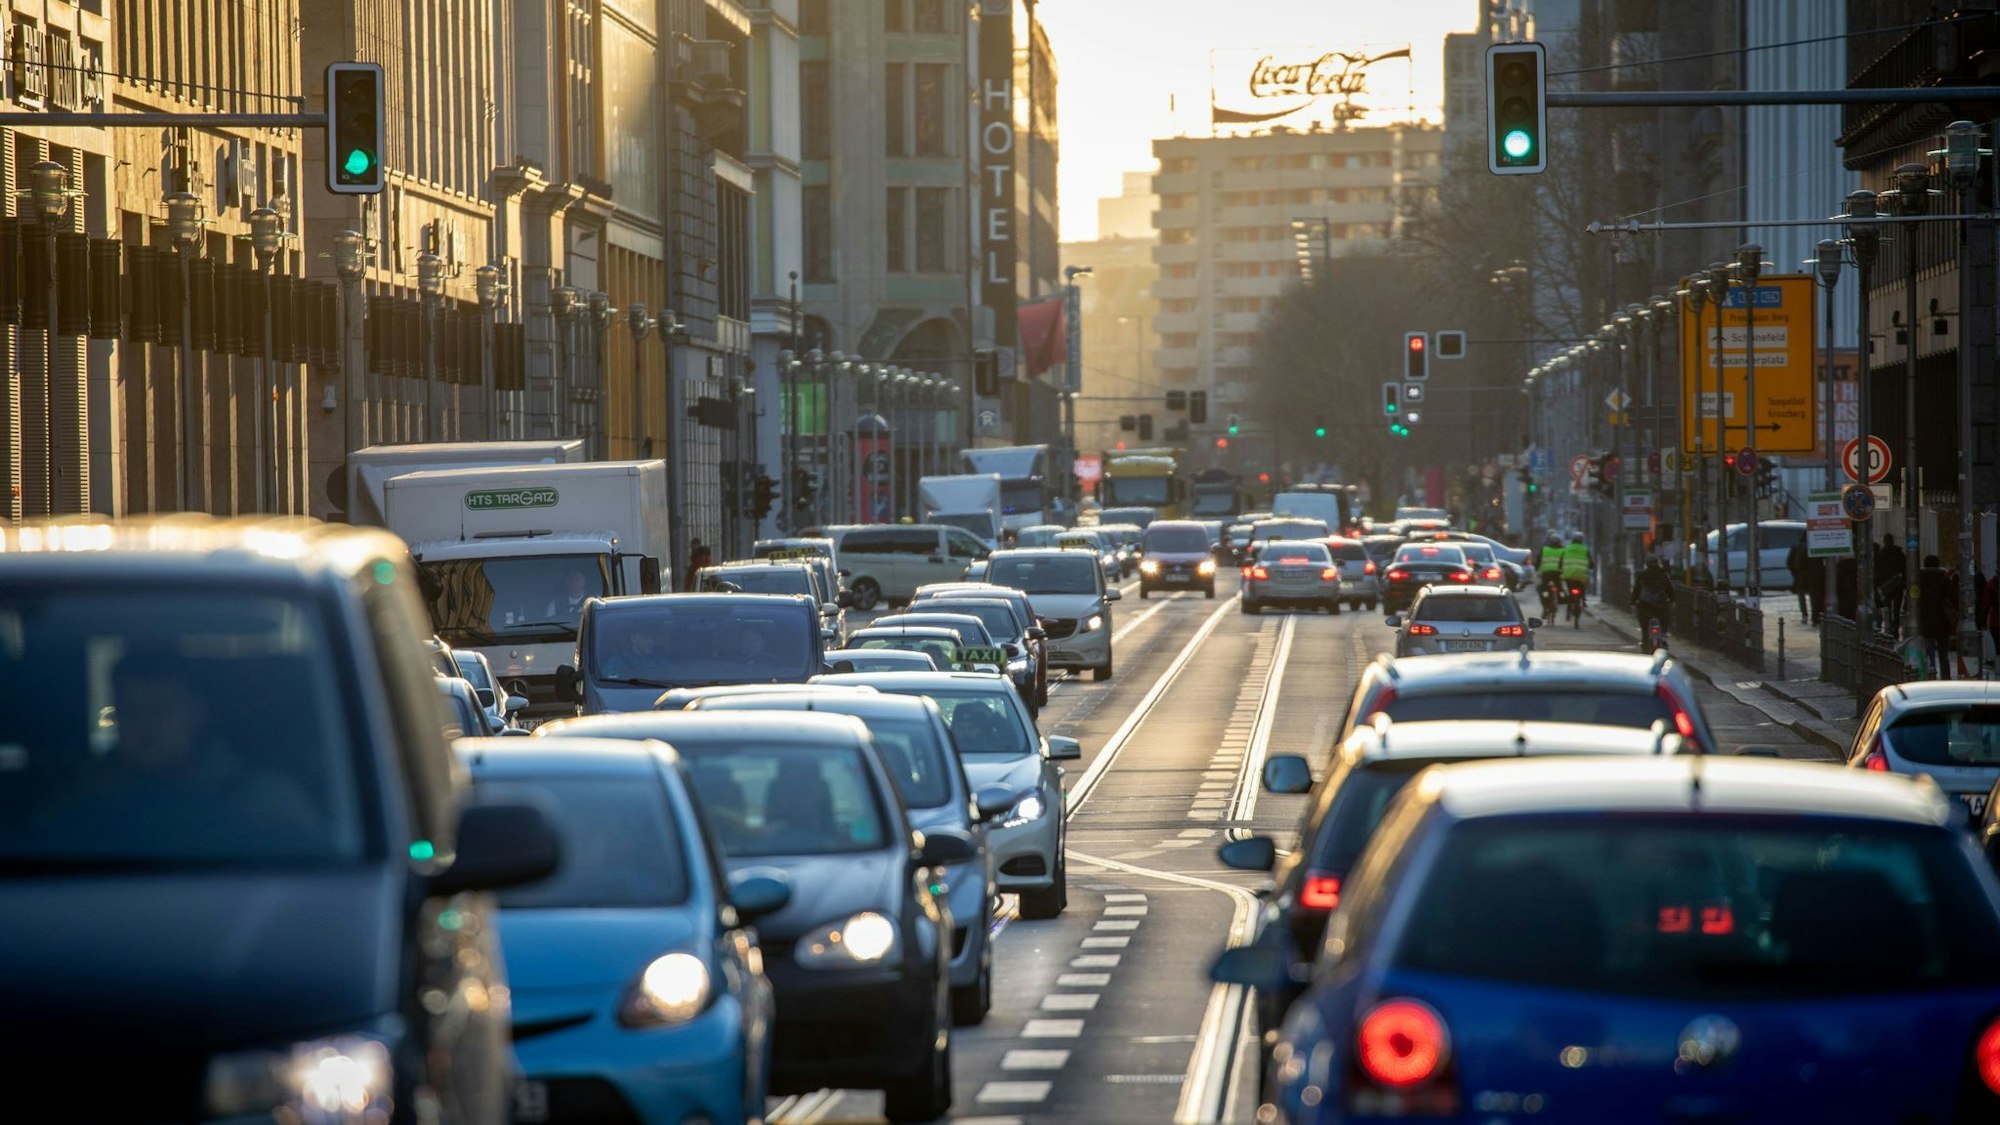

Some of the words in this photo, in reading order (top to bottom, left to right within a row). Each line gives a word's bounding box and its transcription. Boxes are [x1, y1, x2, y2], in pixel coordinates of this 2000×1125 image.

[983, 78, 1012, 285] HOTEL
[468, 495, 492, 506] HTS
[960, 649, 997, 661] TAXI
